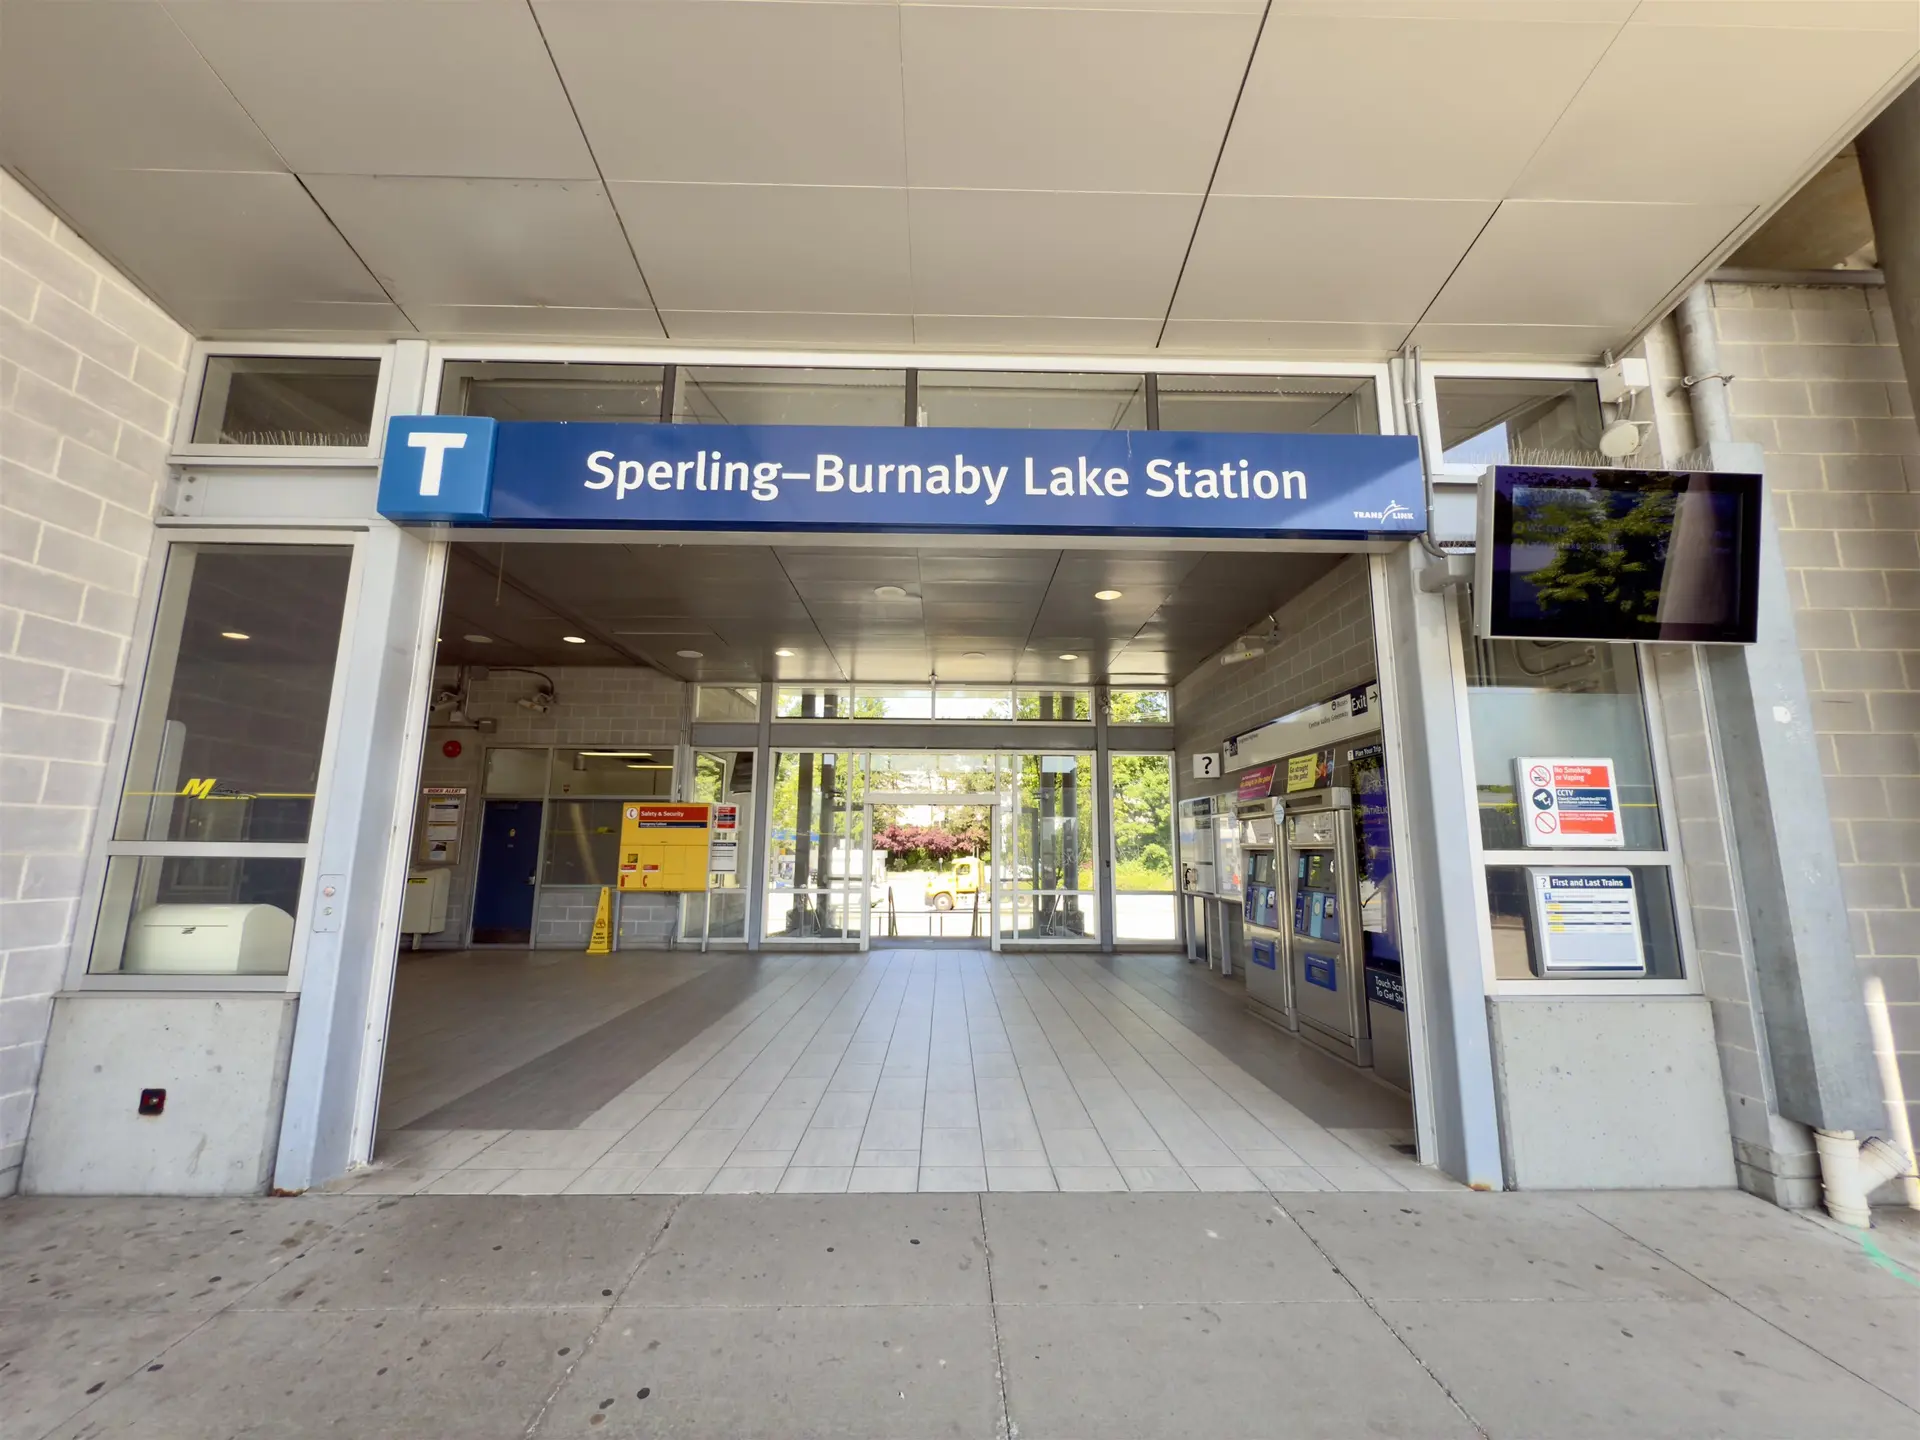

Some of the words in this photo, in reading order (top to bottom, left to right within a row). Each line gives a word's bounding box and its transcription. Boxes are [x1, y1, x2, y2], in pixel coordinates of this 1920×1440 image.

[407, 432, 469, 496] T
[1024, 456, 1129, 498] Lake
[1145, 458, 1308, 500] Station
[1351, 694, 1367, 711] Exit
[1355, 749, 1363, 757] Plan
[1364, 747, 1373, 755] Your
[1373, 745, 1381, 753] Trip
[1563, 767, 1591, 775] Smoking
[641, 810, 657, 818] Safety
[663, 810, 685, 818] Security
[1551, 878, 1569, 887] First
[1570, 878, 1583, 887] and
[1584, 878, 1601, 887] Last
[1601, 878, 1624, 887] Trains
[1375, 975, 1391, 989] Touch
[1376, 986, 1383, 997] To
[1384, 989, 1394, 1000] Get
